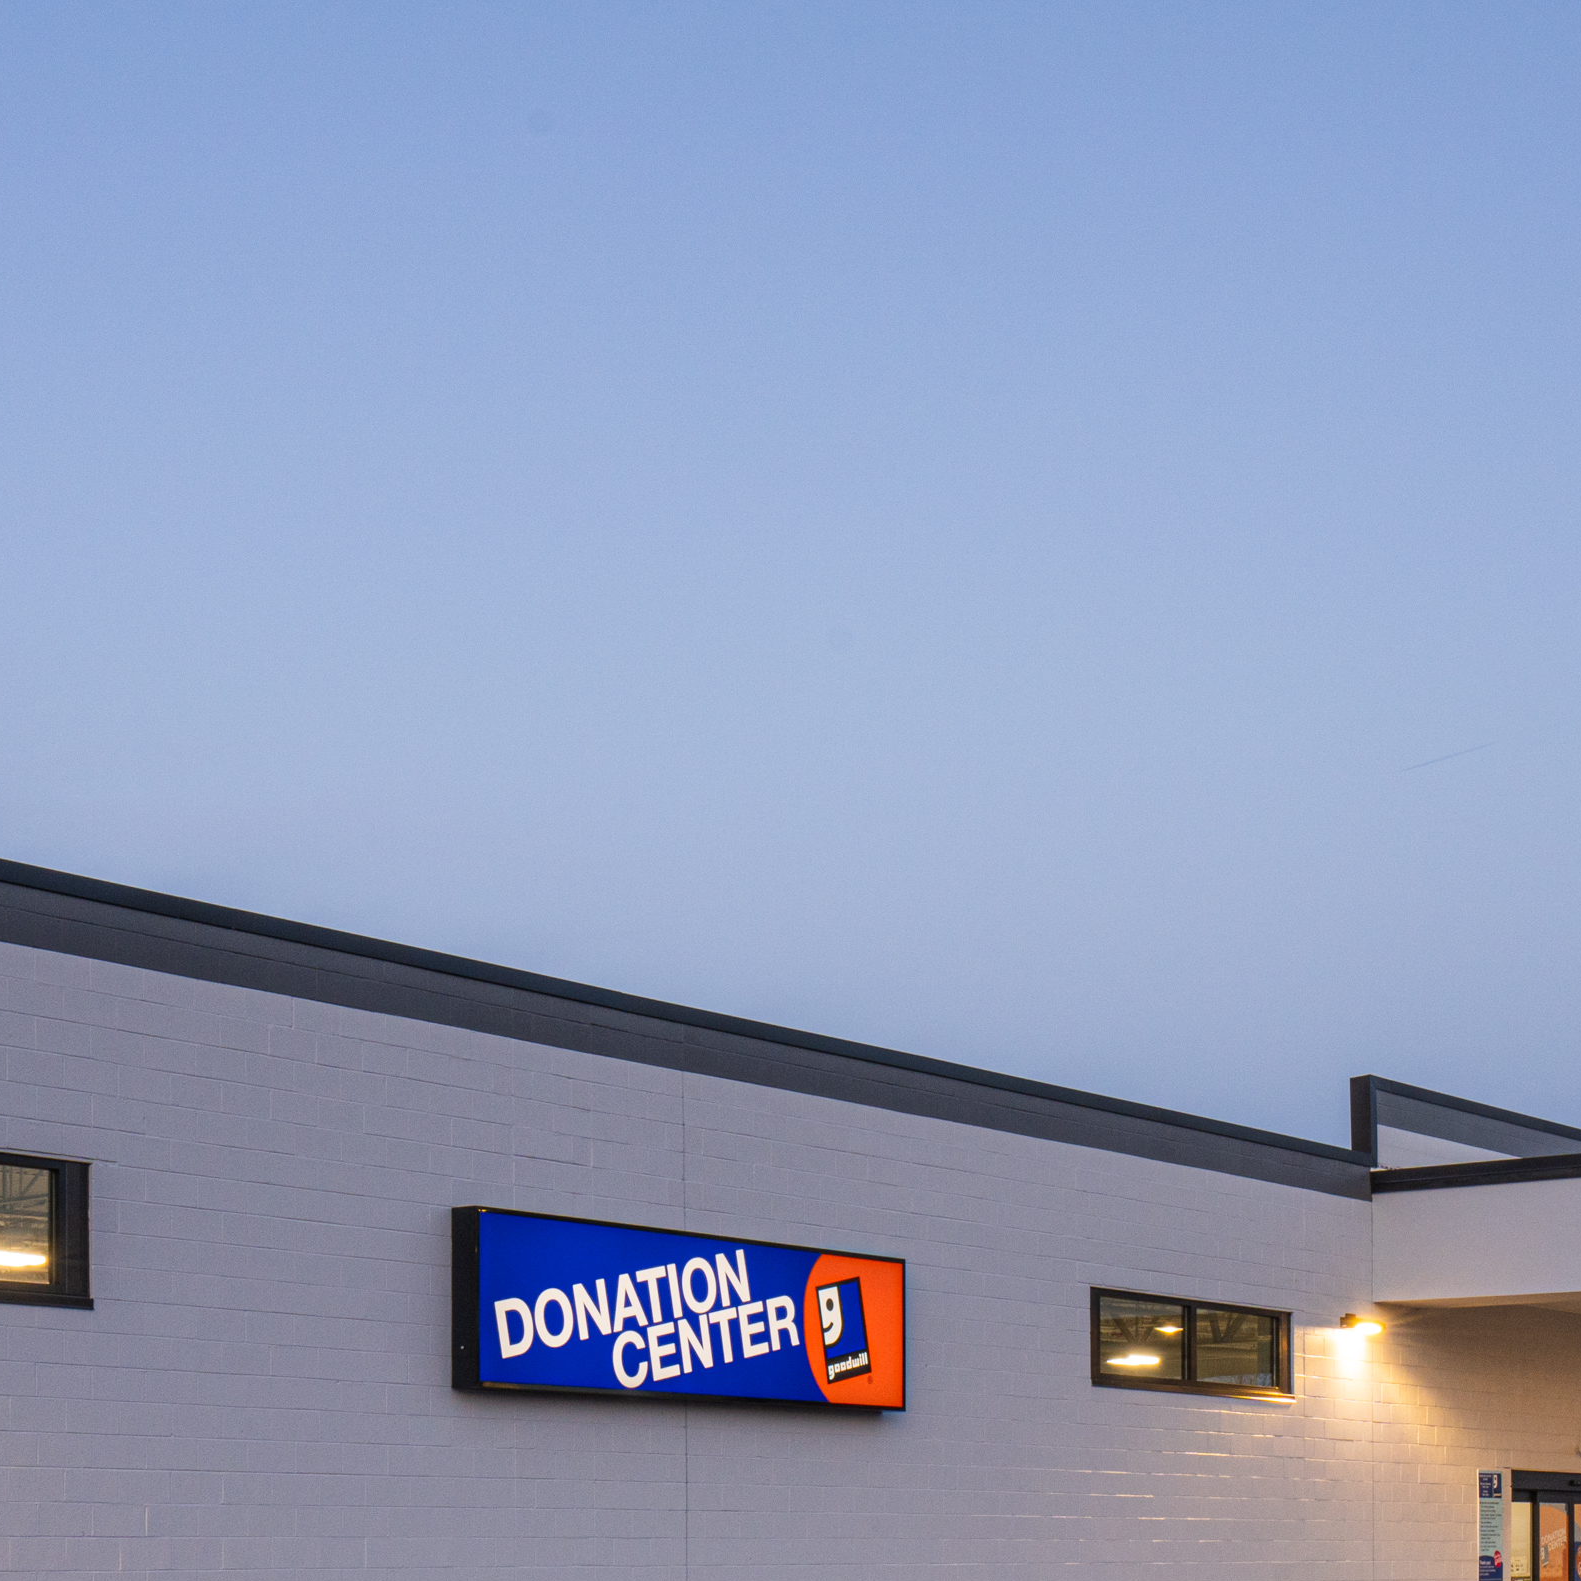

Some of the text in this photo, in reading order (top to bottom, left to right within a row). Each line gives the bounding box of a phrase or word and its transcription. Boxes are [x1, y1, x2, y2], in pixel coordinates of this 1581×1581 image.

[494, 1249, 751, 1359] DONATION
[612, 1295, 800, 1388] CENTER
[828, 1352, 869, 1380] goodwill
